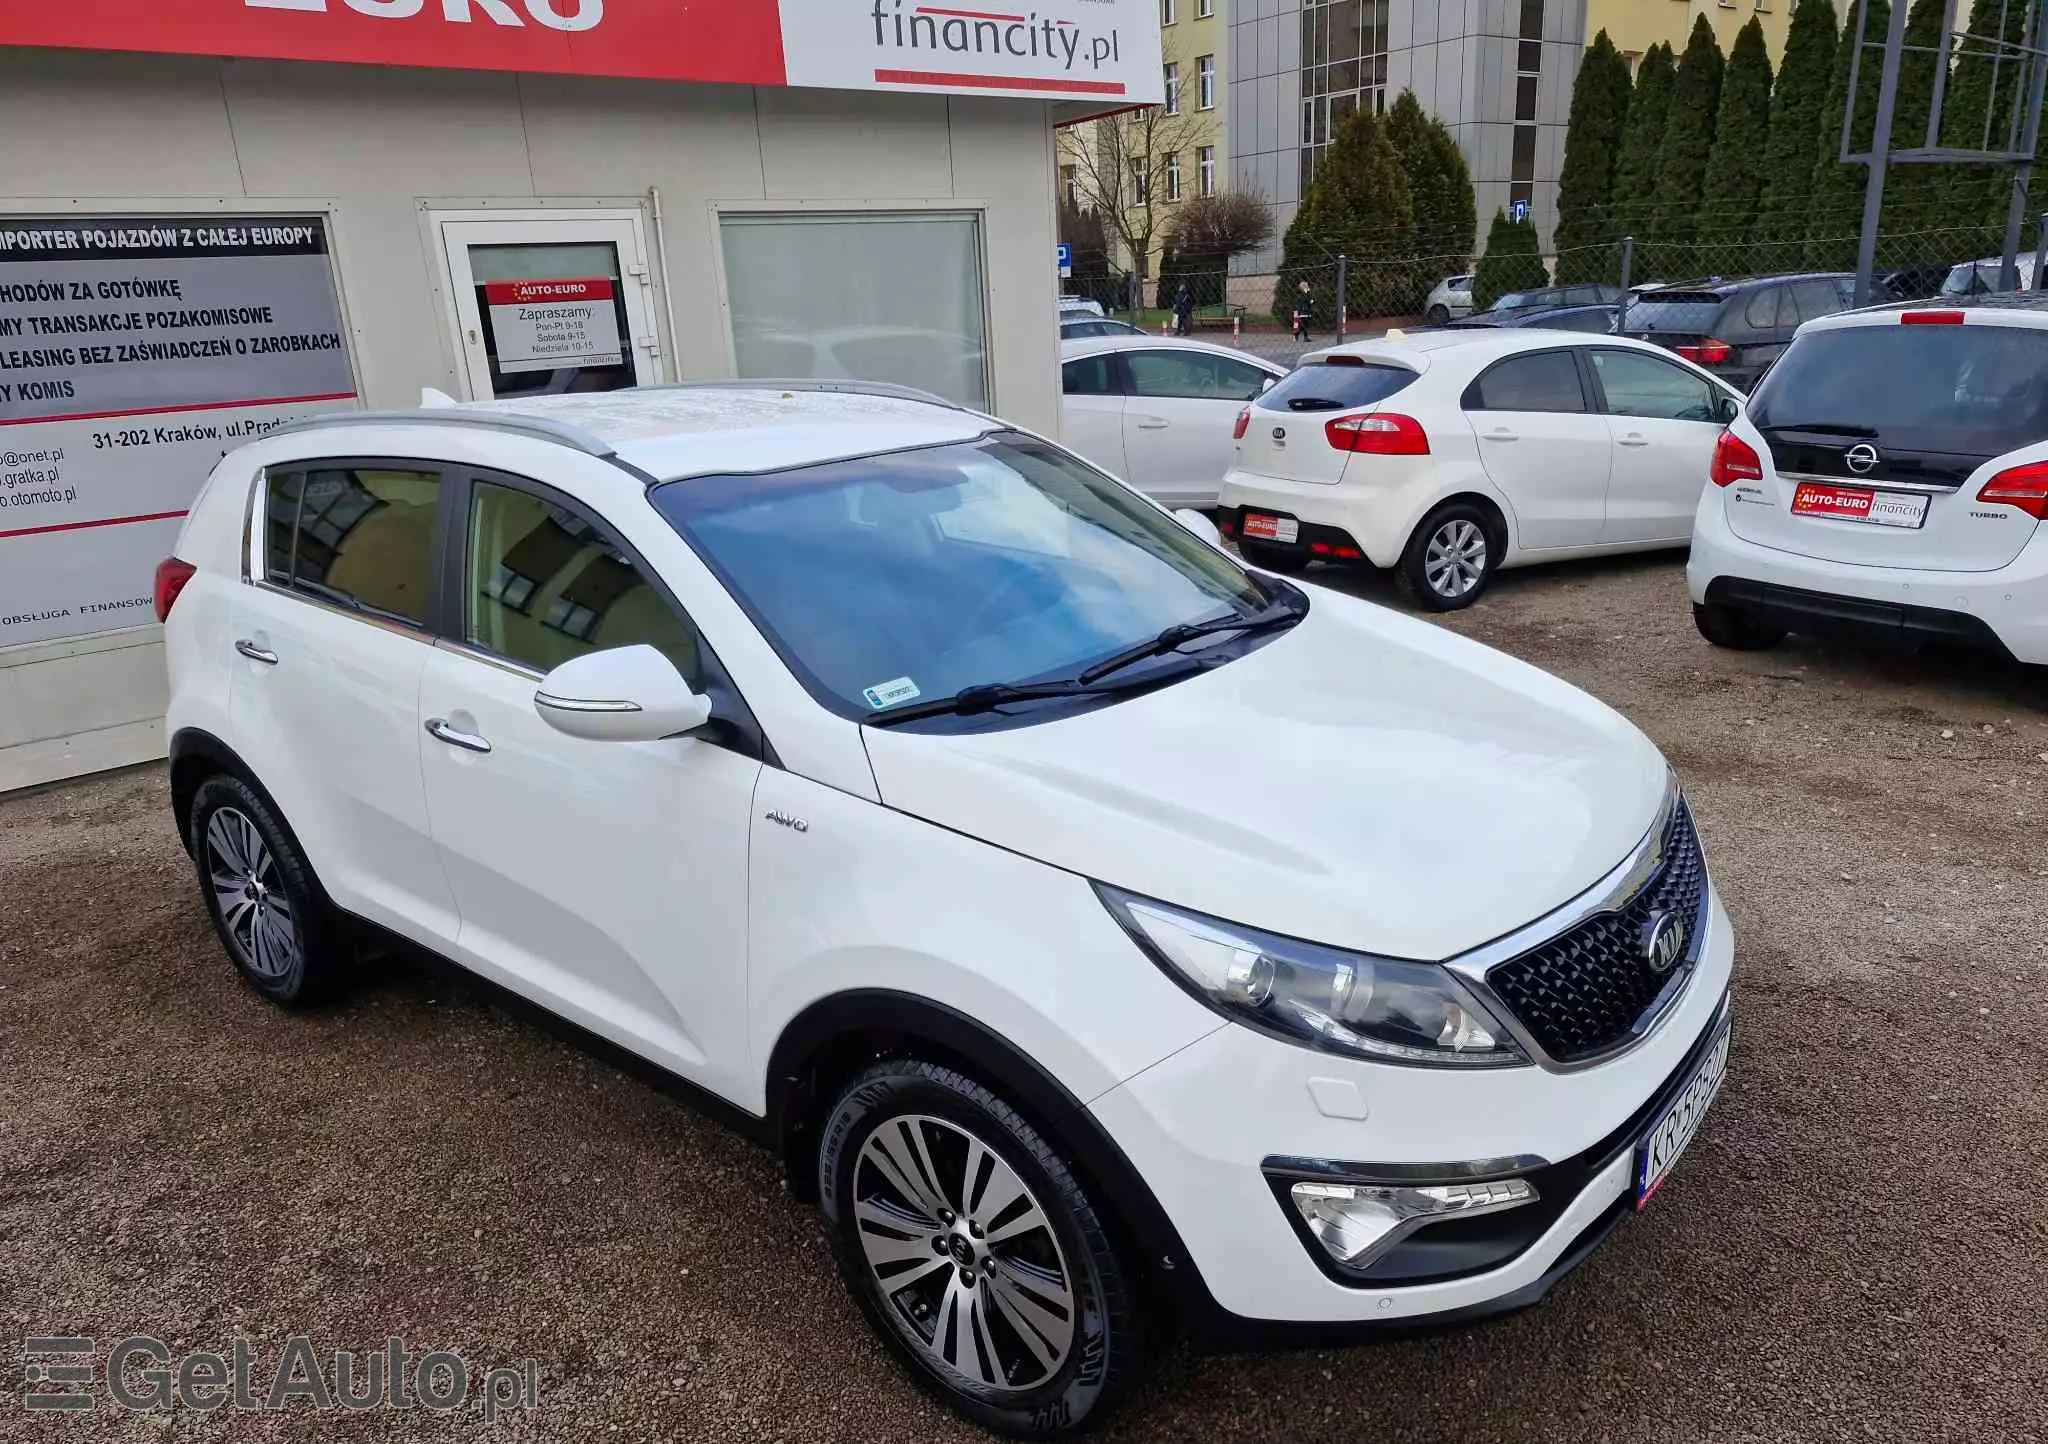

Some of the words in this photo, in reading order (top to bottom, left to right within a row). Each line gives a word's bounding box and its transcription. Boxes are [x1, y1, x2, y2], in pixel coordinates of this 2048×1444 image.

[871, 0, 1119, 70] financity.pl
[82, 225, 178, 248] POJAZDÓW
[181, 228, 195, 247] Z
[196, 227, 248, 247] CAŁEJ
[251, 226, 313, 245] EUROPY
[68, 281, 95, 300] ZA
[97, 276, 183, 301] GOTÓWKĘ
[521, 283, 587, 296] AUTO-EURO
[27, 312, 144, 335] TRANSAKCJE
[145, 306, 274, 330] POZAKOMISOWE
[519, 307, 592, 322] Zapraszamy
[537, 333, 566, 343] Sobota
[0, 347, 76, 369] LEASING
[79, 345, 114, 365] BEZ
[116, 335, 232, 363] ZAŚWIADCZEŃ
[235, 338, 247, 355] O
[250, 332, 342, 354] ZAROBKACH
[17, 379, 75, 401] KOMIS
[92, 428, 151, 449] 31-202
[153, 424, 222, 443] Kraków,
[0, 466, 60, 488] .gratka.pl
[1802, 493, 1869, 509] AUTO-EURO
[2, 608, 71, 626] OBSŁUGA
[1651, 1108, 1677, 1177] KR
